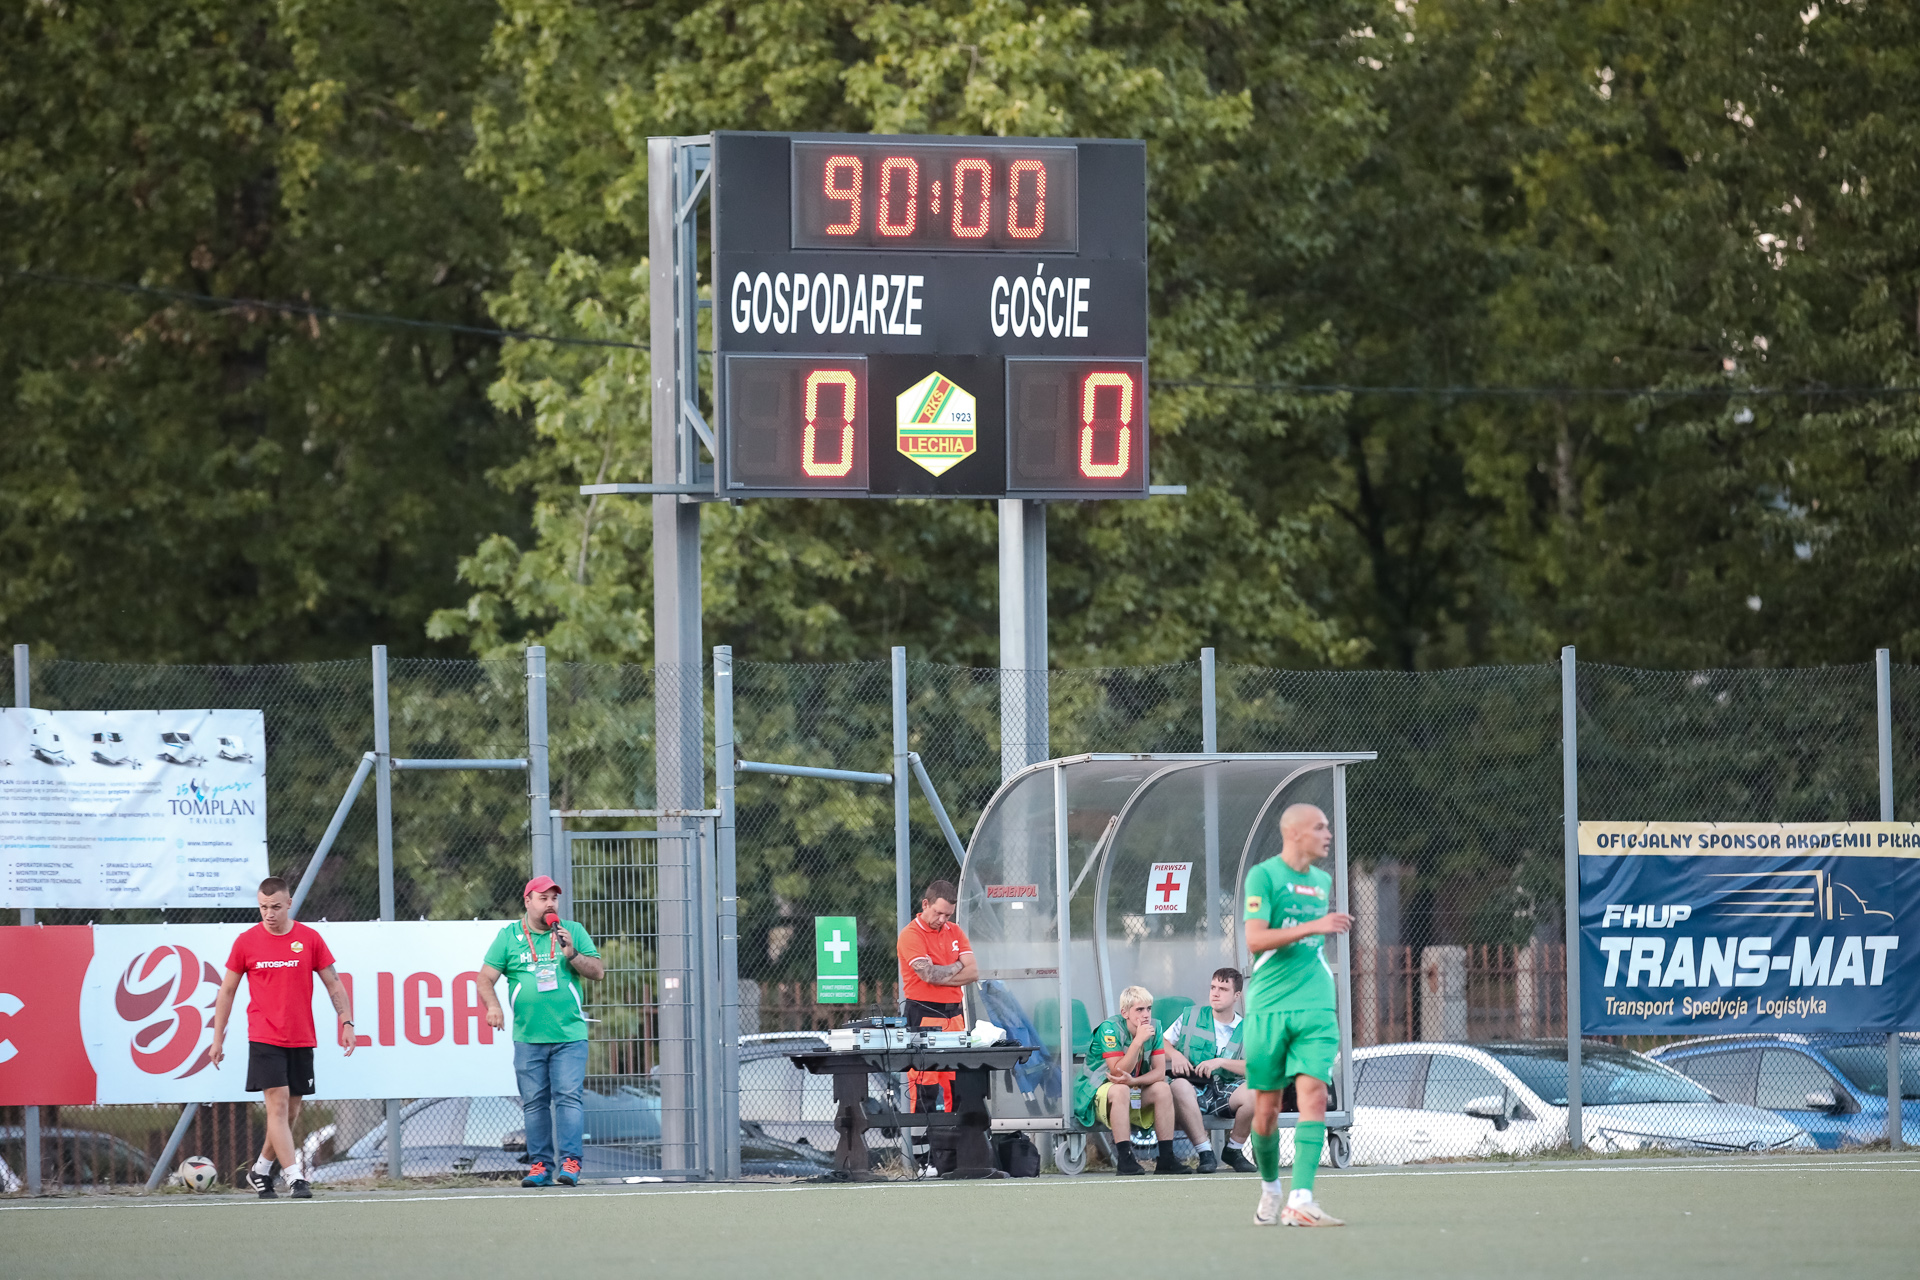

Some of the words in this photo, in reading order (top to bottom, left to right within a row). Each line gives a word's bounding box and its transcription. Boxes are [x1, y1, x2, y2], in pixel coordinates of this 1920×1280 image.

[824, 155, 1046, 239] 90:00
[731, 271, 925, 336] GOSPODARZE
[990, 263, 1091, 338] GOŚCIE
[924, 389, 945, 419] RKS
[951, 412, 972, 422] 1923
[802, 369, 857, 478] 0
[1080, 372, 1133, 478] 0
[908, 437, 966, 453] LECHIA
[167, 798, 255, 816] TOMPLAN
[189, 817, 236, 825] TRAILERS
[1596, 833, 1693, 849] OFICJALNY
[1698, 833, 1781, 849] SPONSOR
[1785, 832, 1872, 849] AKADEMII
[986, 885, 1038, 899] PESMENPOL
[1601, 904, 1692, 929] FHUP
[1600, 936, 1899, 988] TRANS-MAT
[337, 971, 494, 1047] LIGA
[1605, 996, 1674, 1019] Transport
[1682, 996, 1748, 1020] Spedycja
[1756, 995, 1827, 1019] Logistyka
